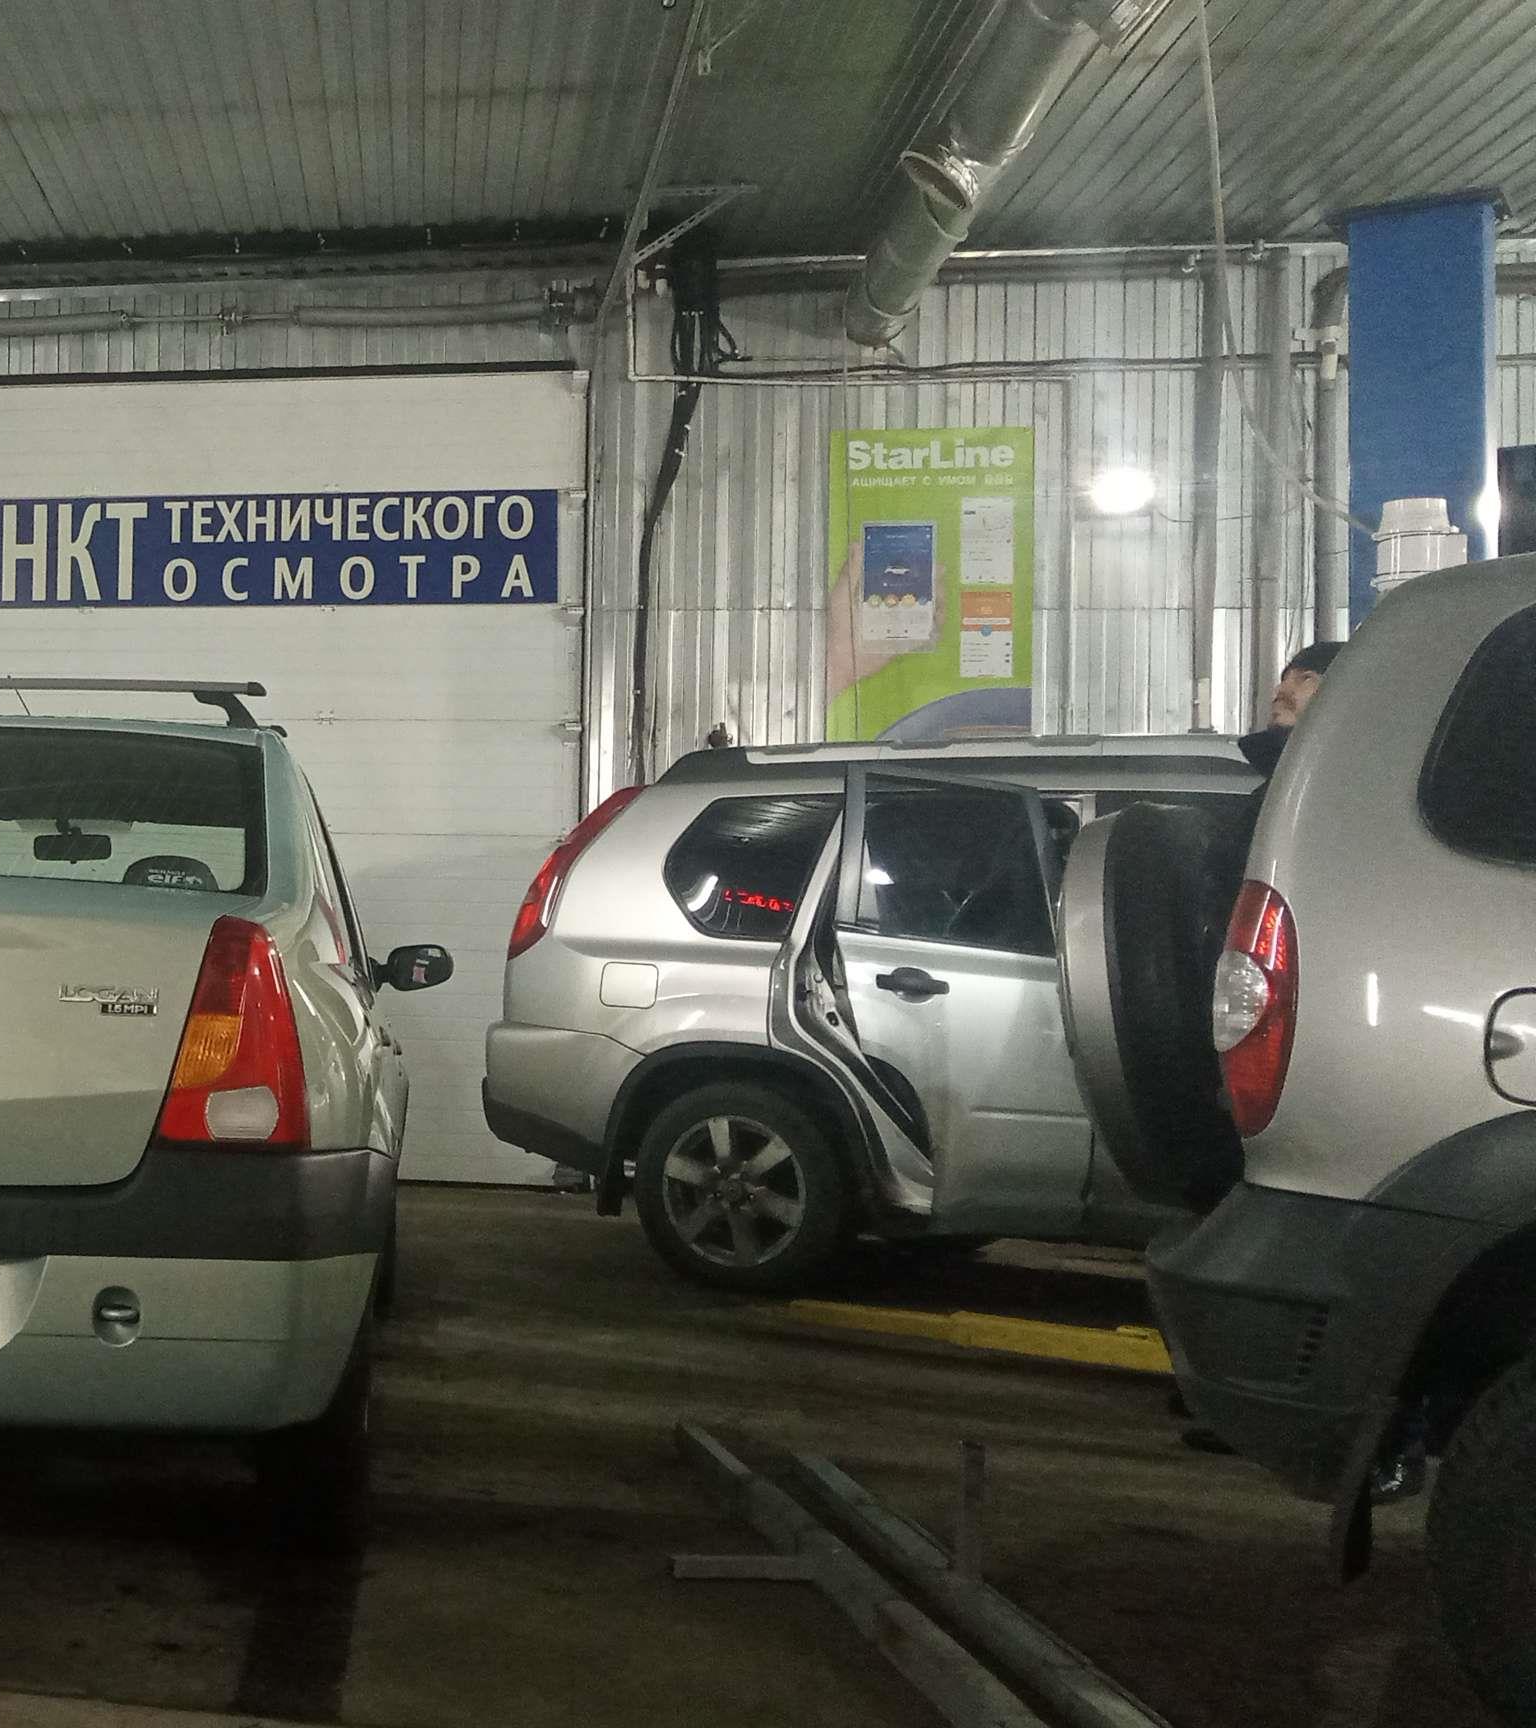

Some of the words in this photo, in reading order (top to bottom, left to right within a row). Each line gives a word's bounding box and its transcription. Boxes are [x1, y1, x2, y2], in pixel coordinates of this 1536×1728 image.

[848, 438, 1015, 470] StarLine
[163, 495, 535, 544] ТЕХНИЧЕСКОГО
[162, 554, 535, 602] ОСМОТРА
[58, 984, 160, 1003] LOGAN
